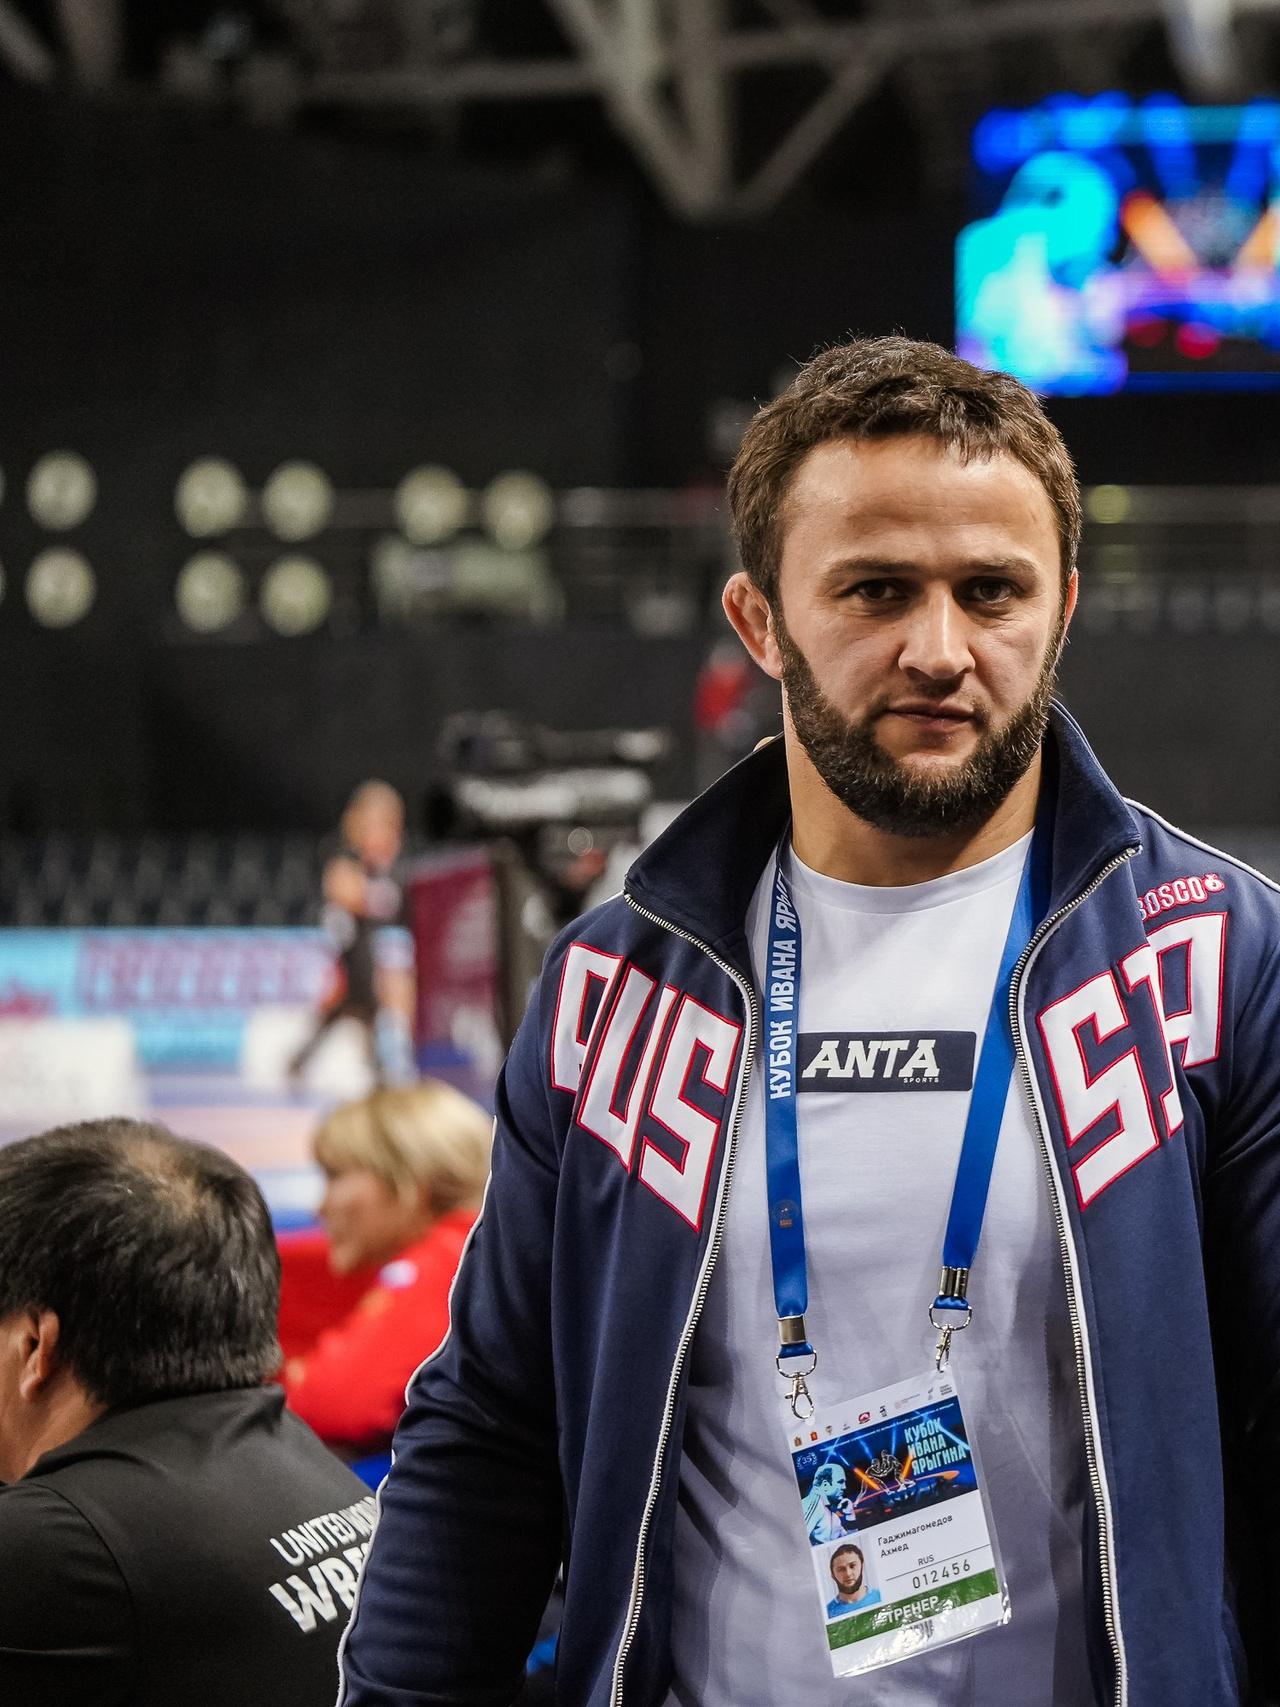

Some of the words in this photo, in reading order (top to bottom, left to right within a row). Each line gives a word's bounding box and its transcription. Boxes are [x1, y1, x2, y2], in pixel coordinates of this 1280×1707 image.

[770, 939, 797, 1013] ИВАНА
[769, 1020, 793, 1100] КУБОК
[802, 1039, 940, 1078] ANTA
[904, 1417, 941, 1443] КУБОК
[907, 1434, 947, 1459] ИВАНА
[911, 1444, 967, 1476] ЯРЫГИНА
[269, 1512, 357, 1567] UNITED
[877, 1514, 954, 1546] Гаджимагомедов
[880, 1543, 910, 1558] Ахмед
[917, 1554, 935, 1566] RUS
[912, 1559, 971, 1589] 012456
[886, 1595, 939, 1623] ТРЕНЕР
